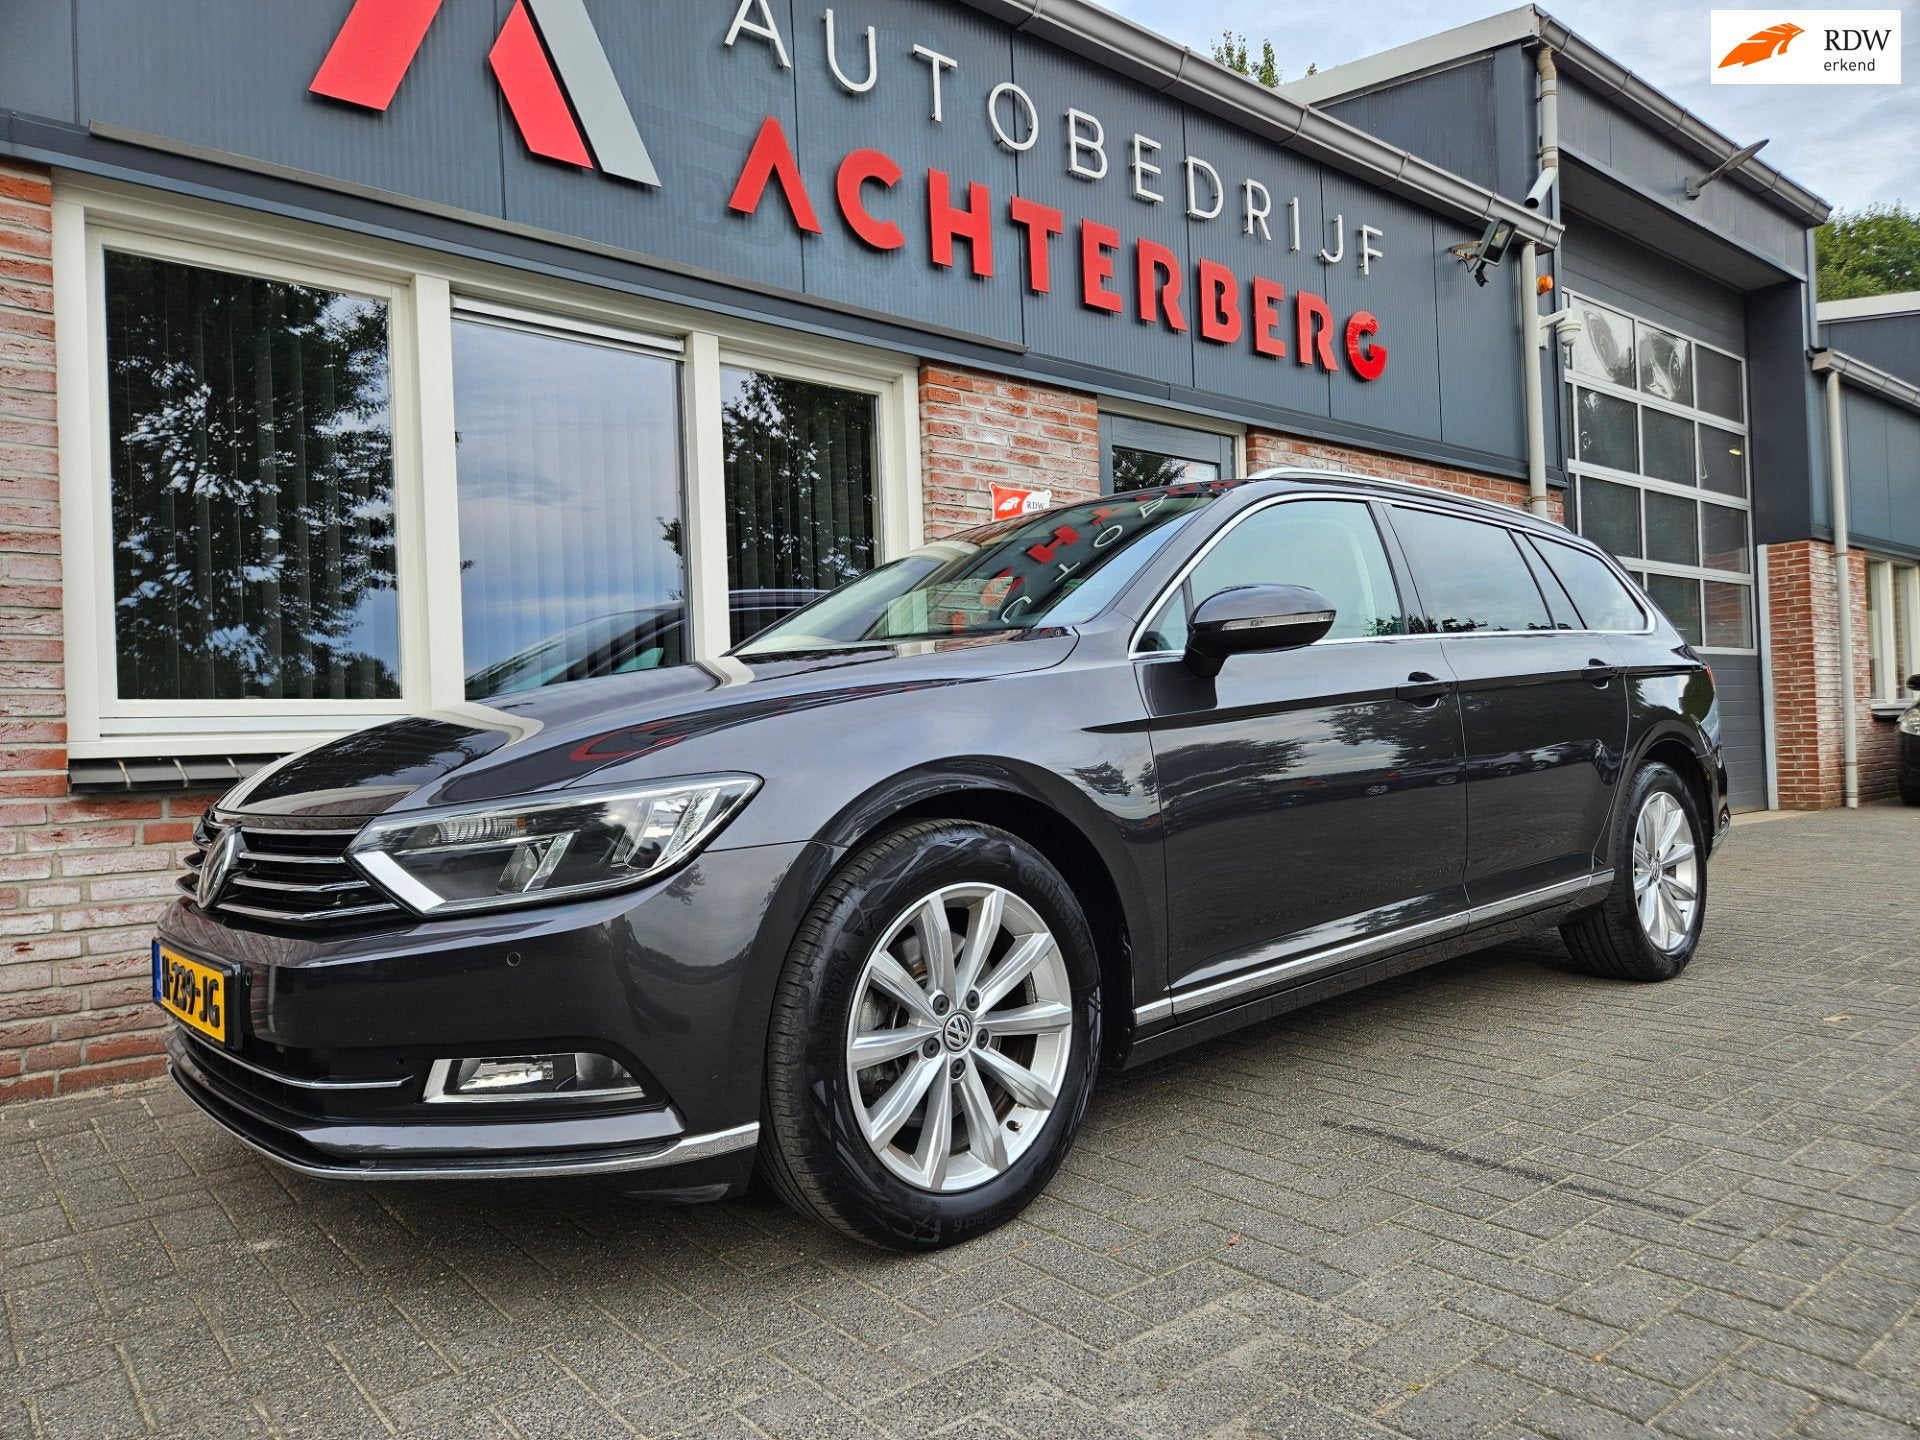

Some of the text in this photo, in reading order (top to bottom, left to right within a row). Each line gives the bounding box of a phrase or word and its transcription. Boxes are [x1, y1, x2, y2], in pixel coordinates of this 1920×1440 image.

[724, 0, 1383, 275] AUTOBEDRIJF
[728, 115, 1387, 381] ACHTERBERG
[1026, 501, 1046, 511] RDW
